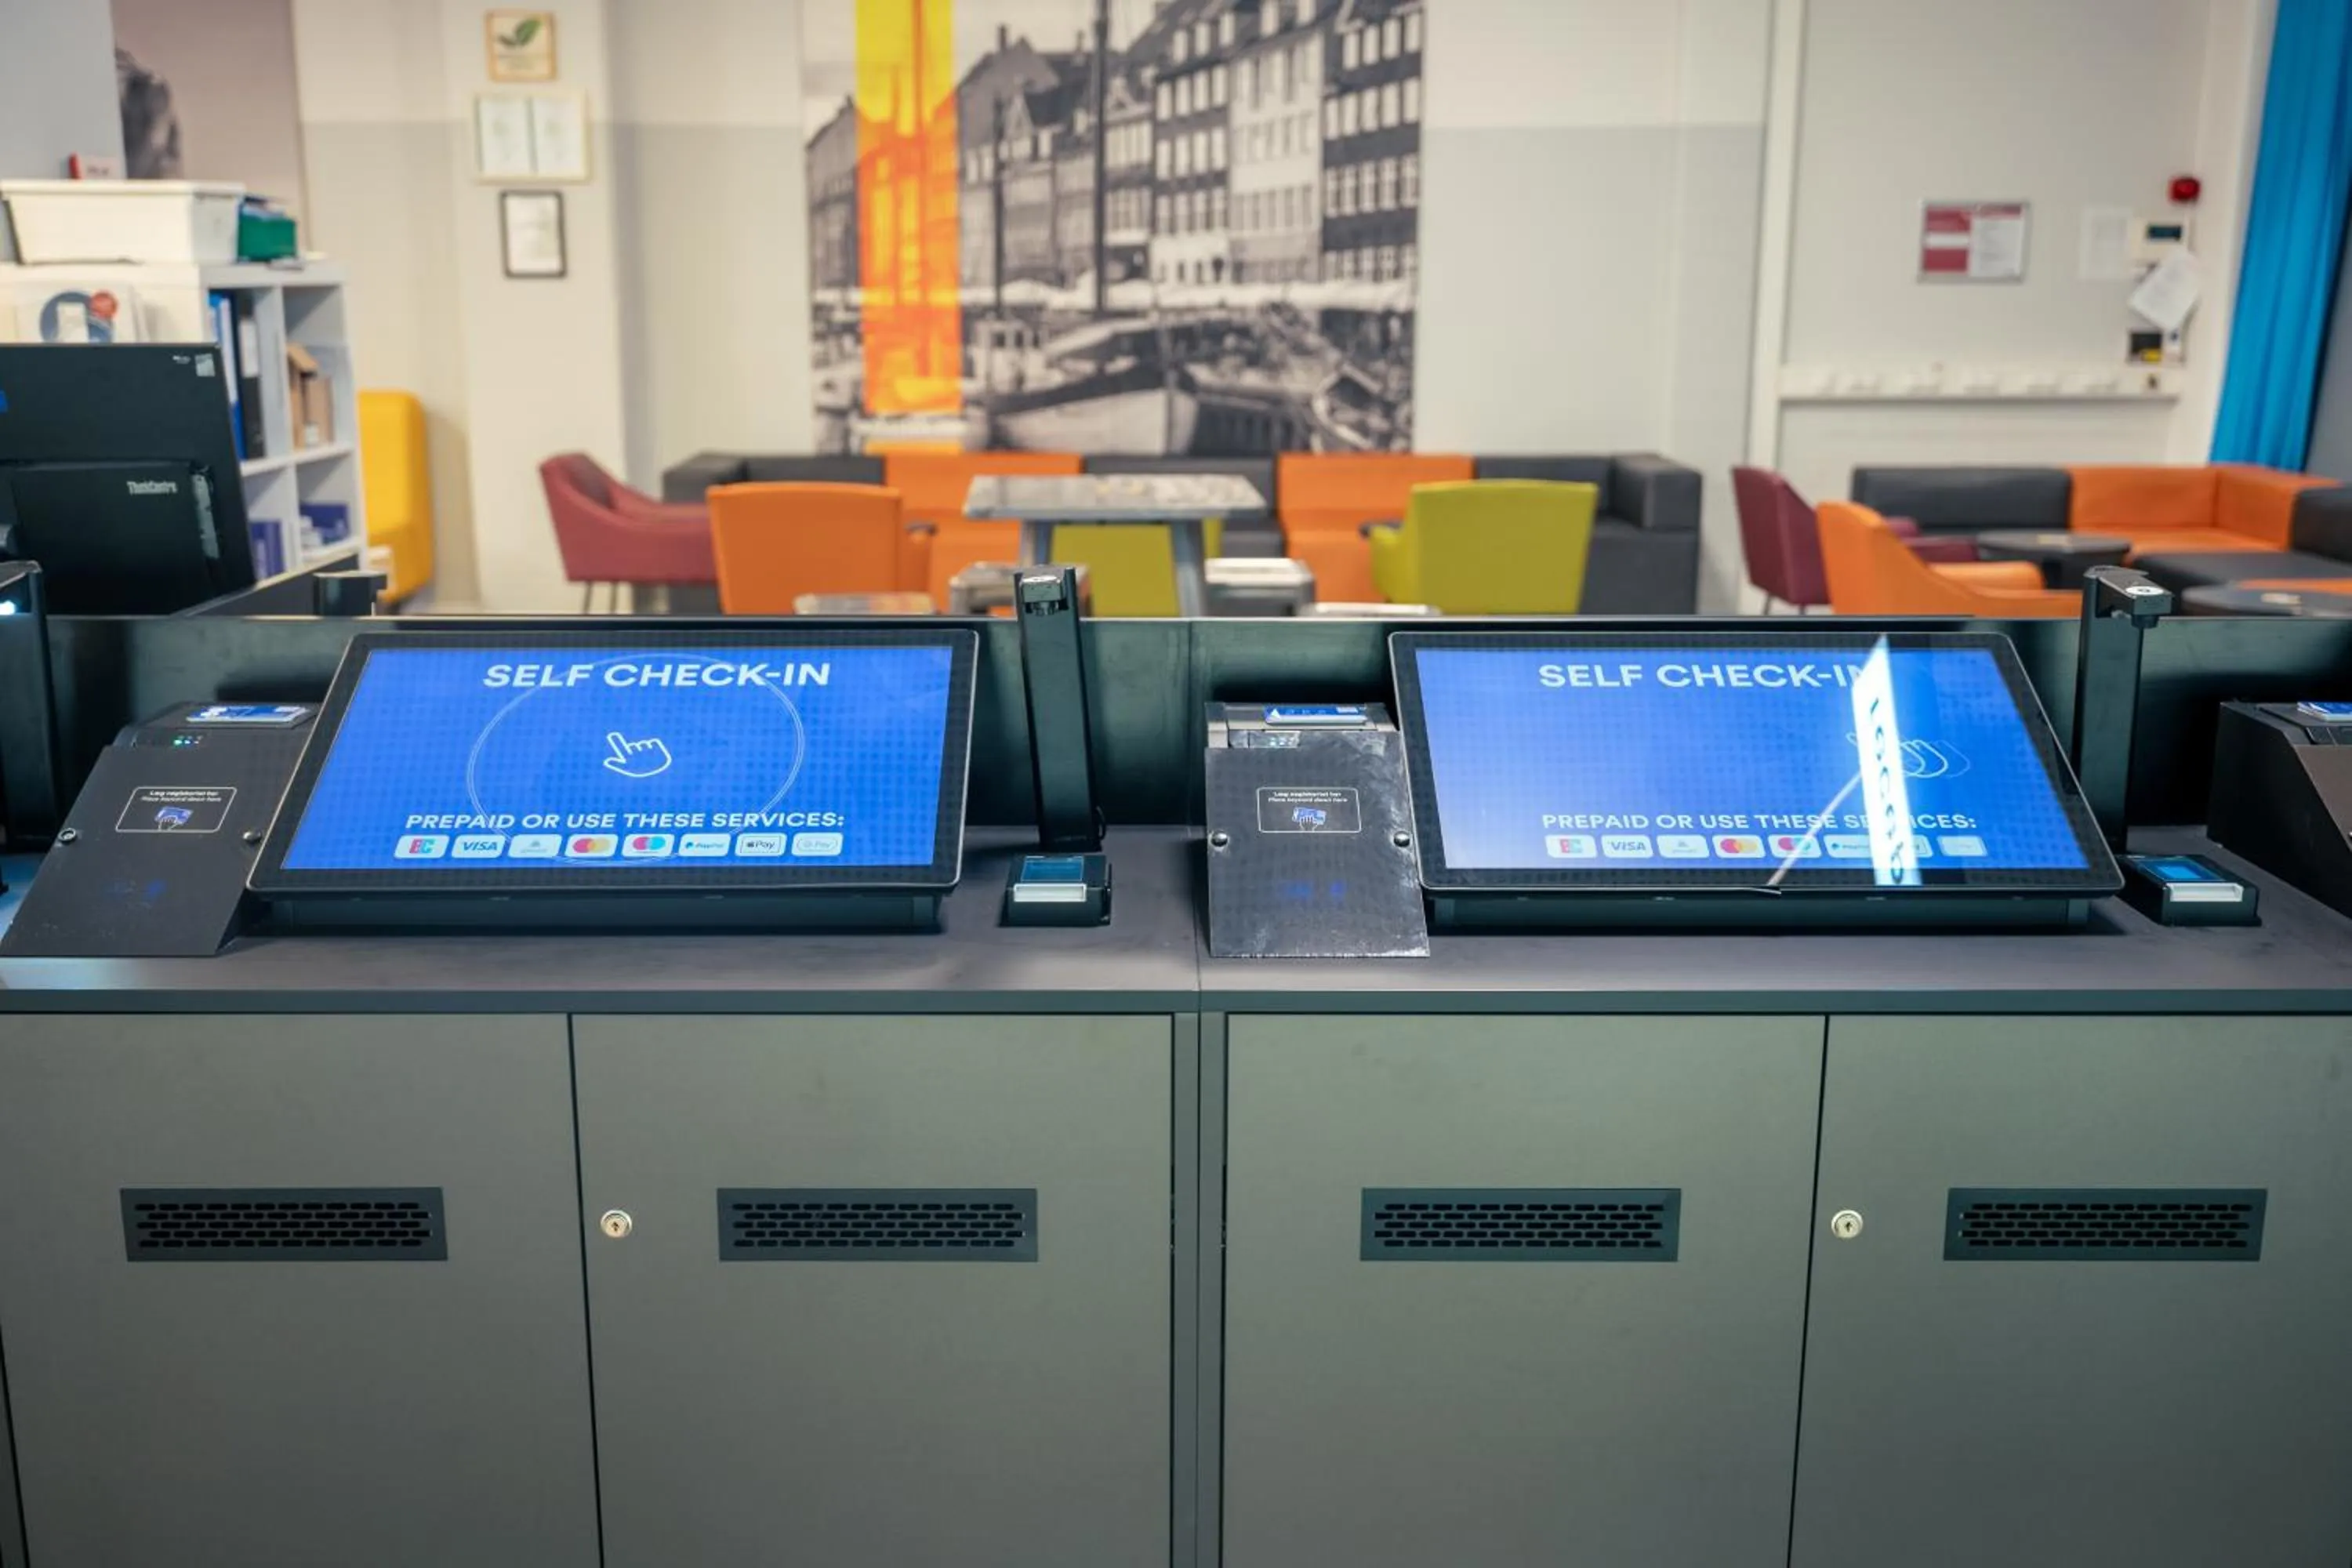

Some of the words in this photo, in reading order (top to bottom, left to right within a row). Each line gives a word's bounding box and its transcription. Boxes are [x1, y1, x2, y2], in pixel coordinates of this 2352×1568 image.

[482, 663, 594, 688] SELF
[603, 662, 831, 687] CHECK-IN
[1538, 663, 1643, 688] SELF
[405, 814, 515, 829] PREPAID
[521, 814, 560, 829] OR
[567, 813, 617, 829] USE
[623, 812, 706, 828] THESE
[711, 811, 845, 828] SERVICES:
[1542, 814, 1650, 829] PREPAID
[1656, 814, 1693, 829] OR
[1699, 814, 1750, 829] USE
[1754, 814, 1838, 829] THESE
[462, 840, 499, 851] VISA
[754, 840, 776, 850] Pay
[1609, 840, 1646, 851] VISA
